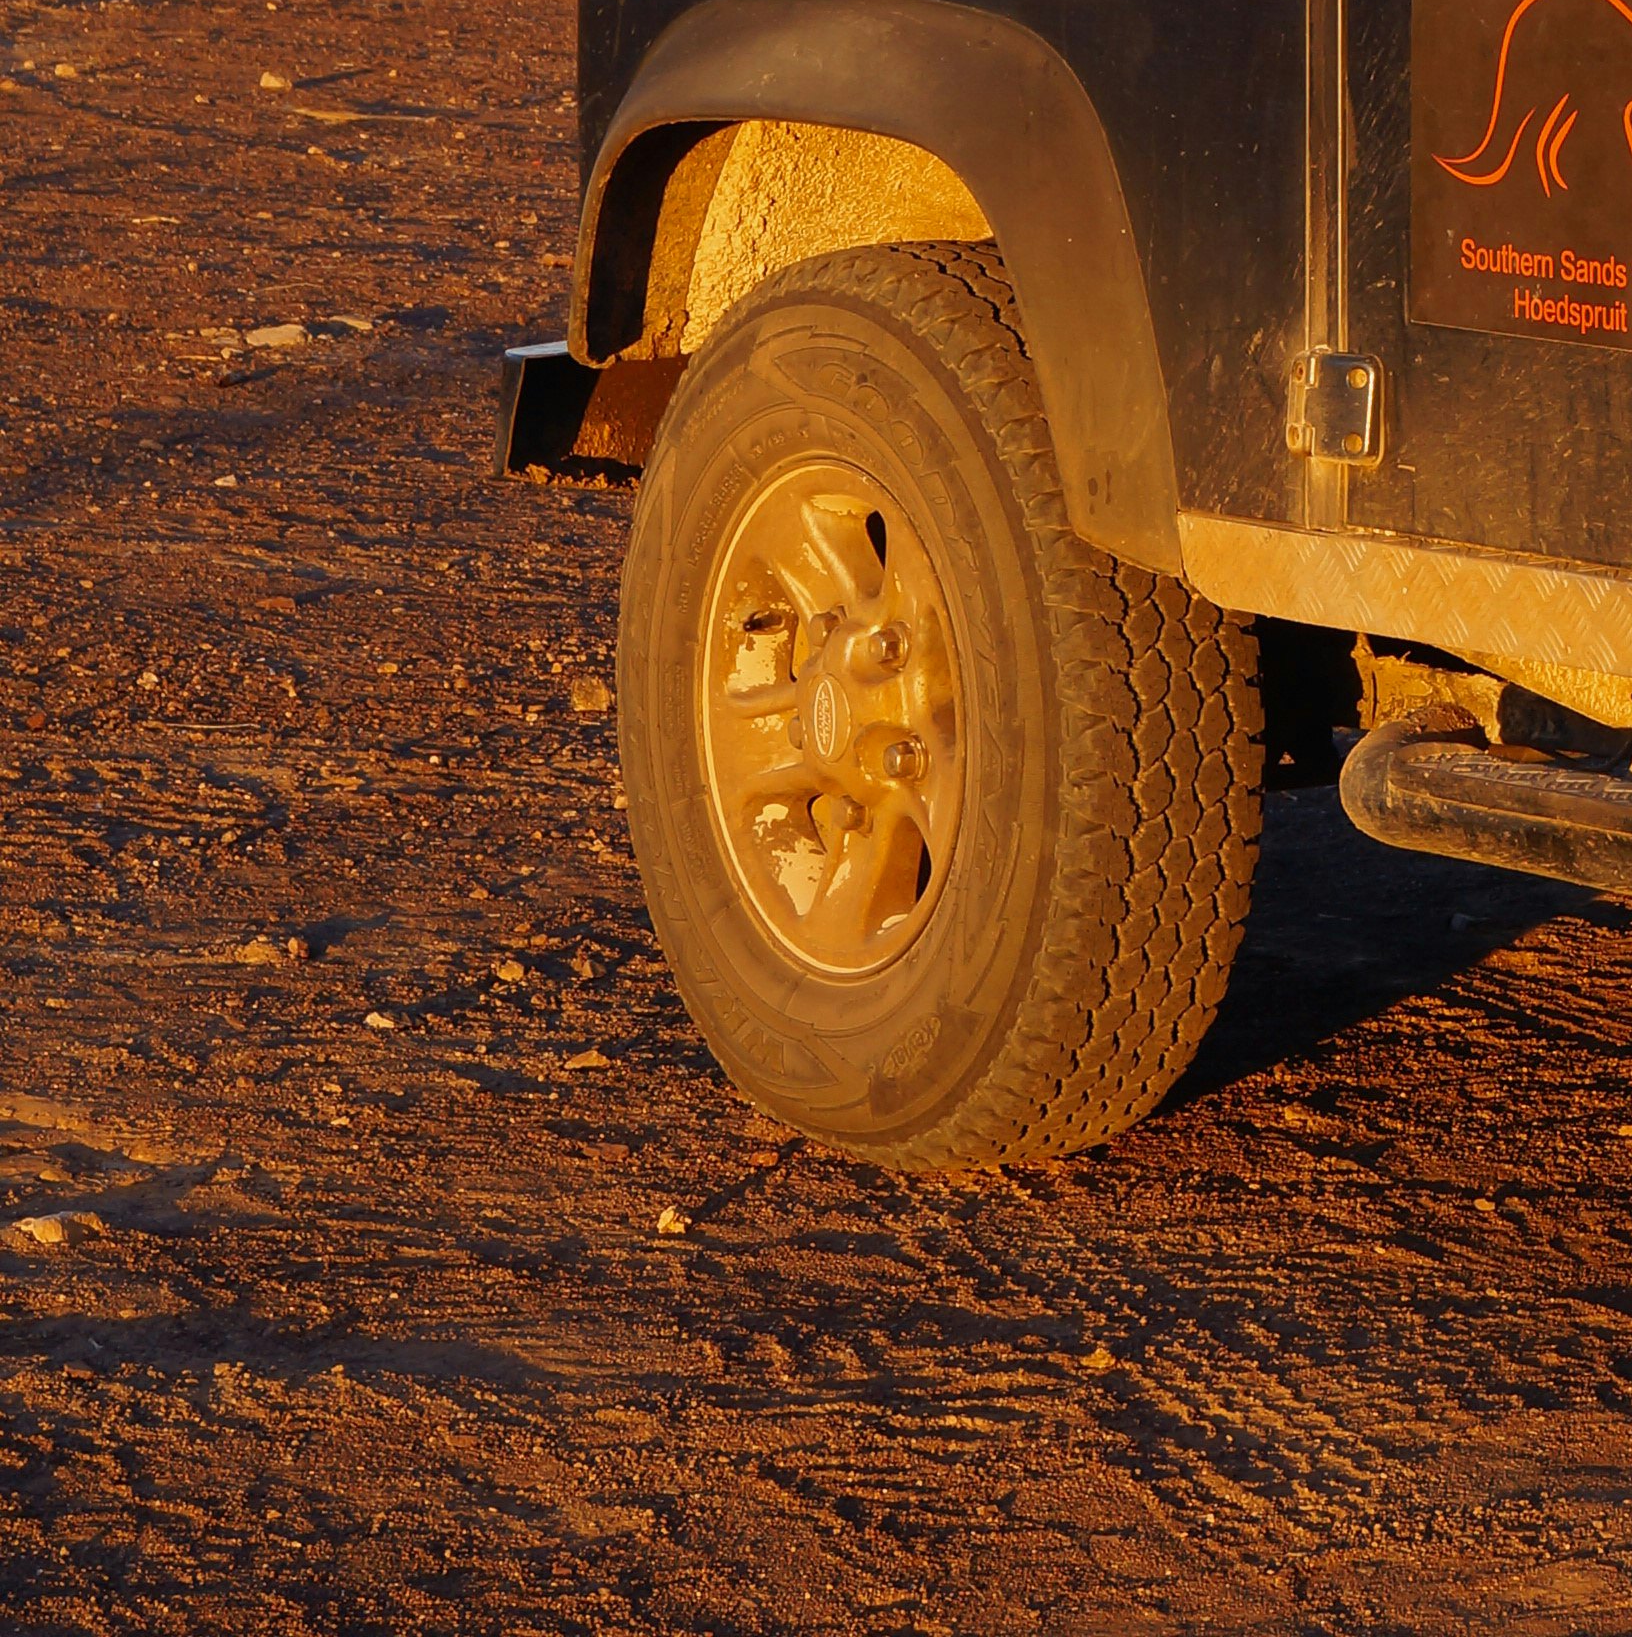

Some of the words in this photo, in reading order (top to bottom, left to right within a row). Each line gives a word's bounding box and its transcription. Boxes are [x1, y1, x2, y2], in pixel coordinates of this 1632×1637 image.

[1460, 238, 1554, 279] Southern
[1560, 250, 1628, 288] Sands
[1514, 288, 1628, 335] Hoedspruit
[815, 361, 1003, 891] GOODYEAR
